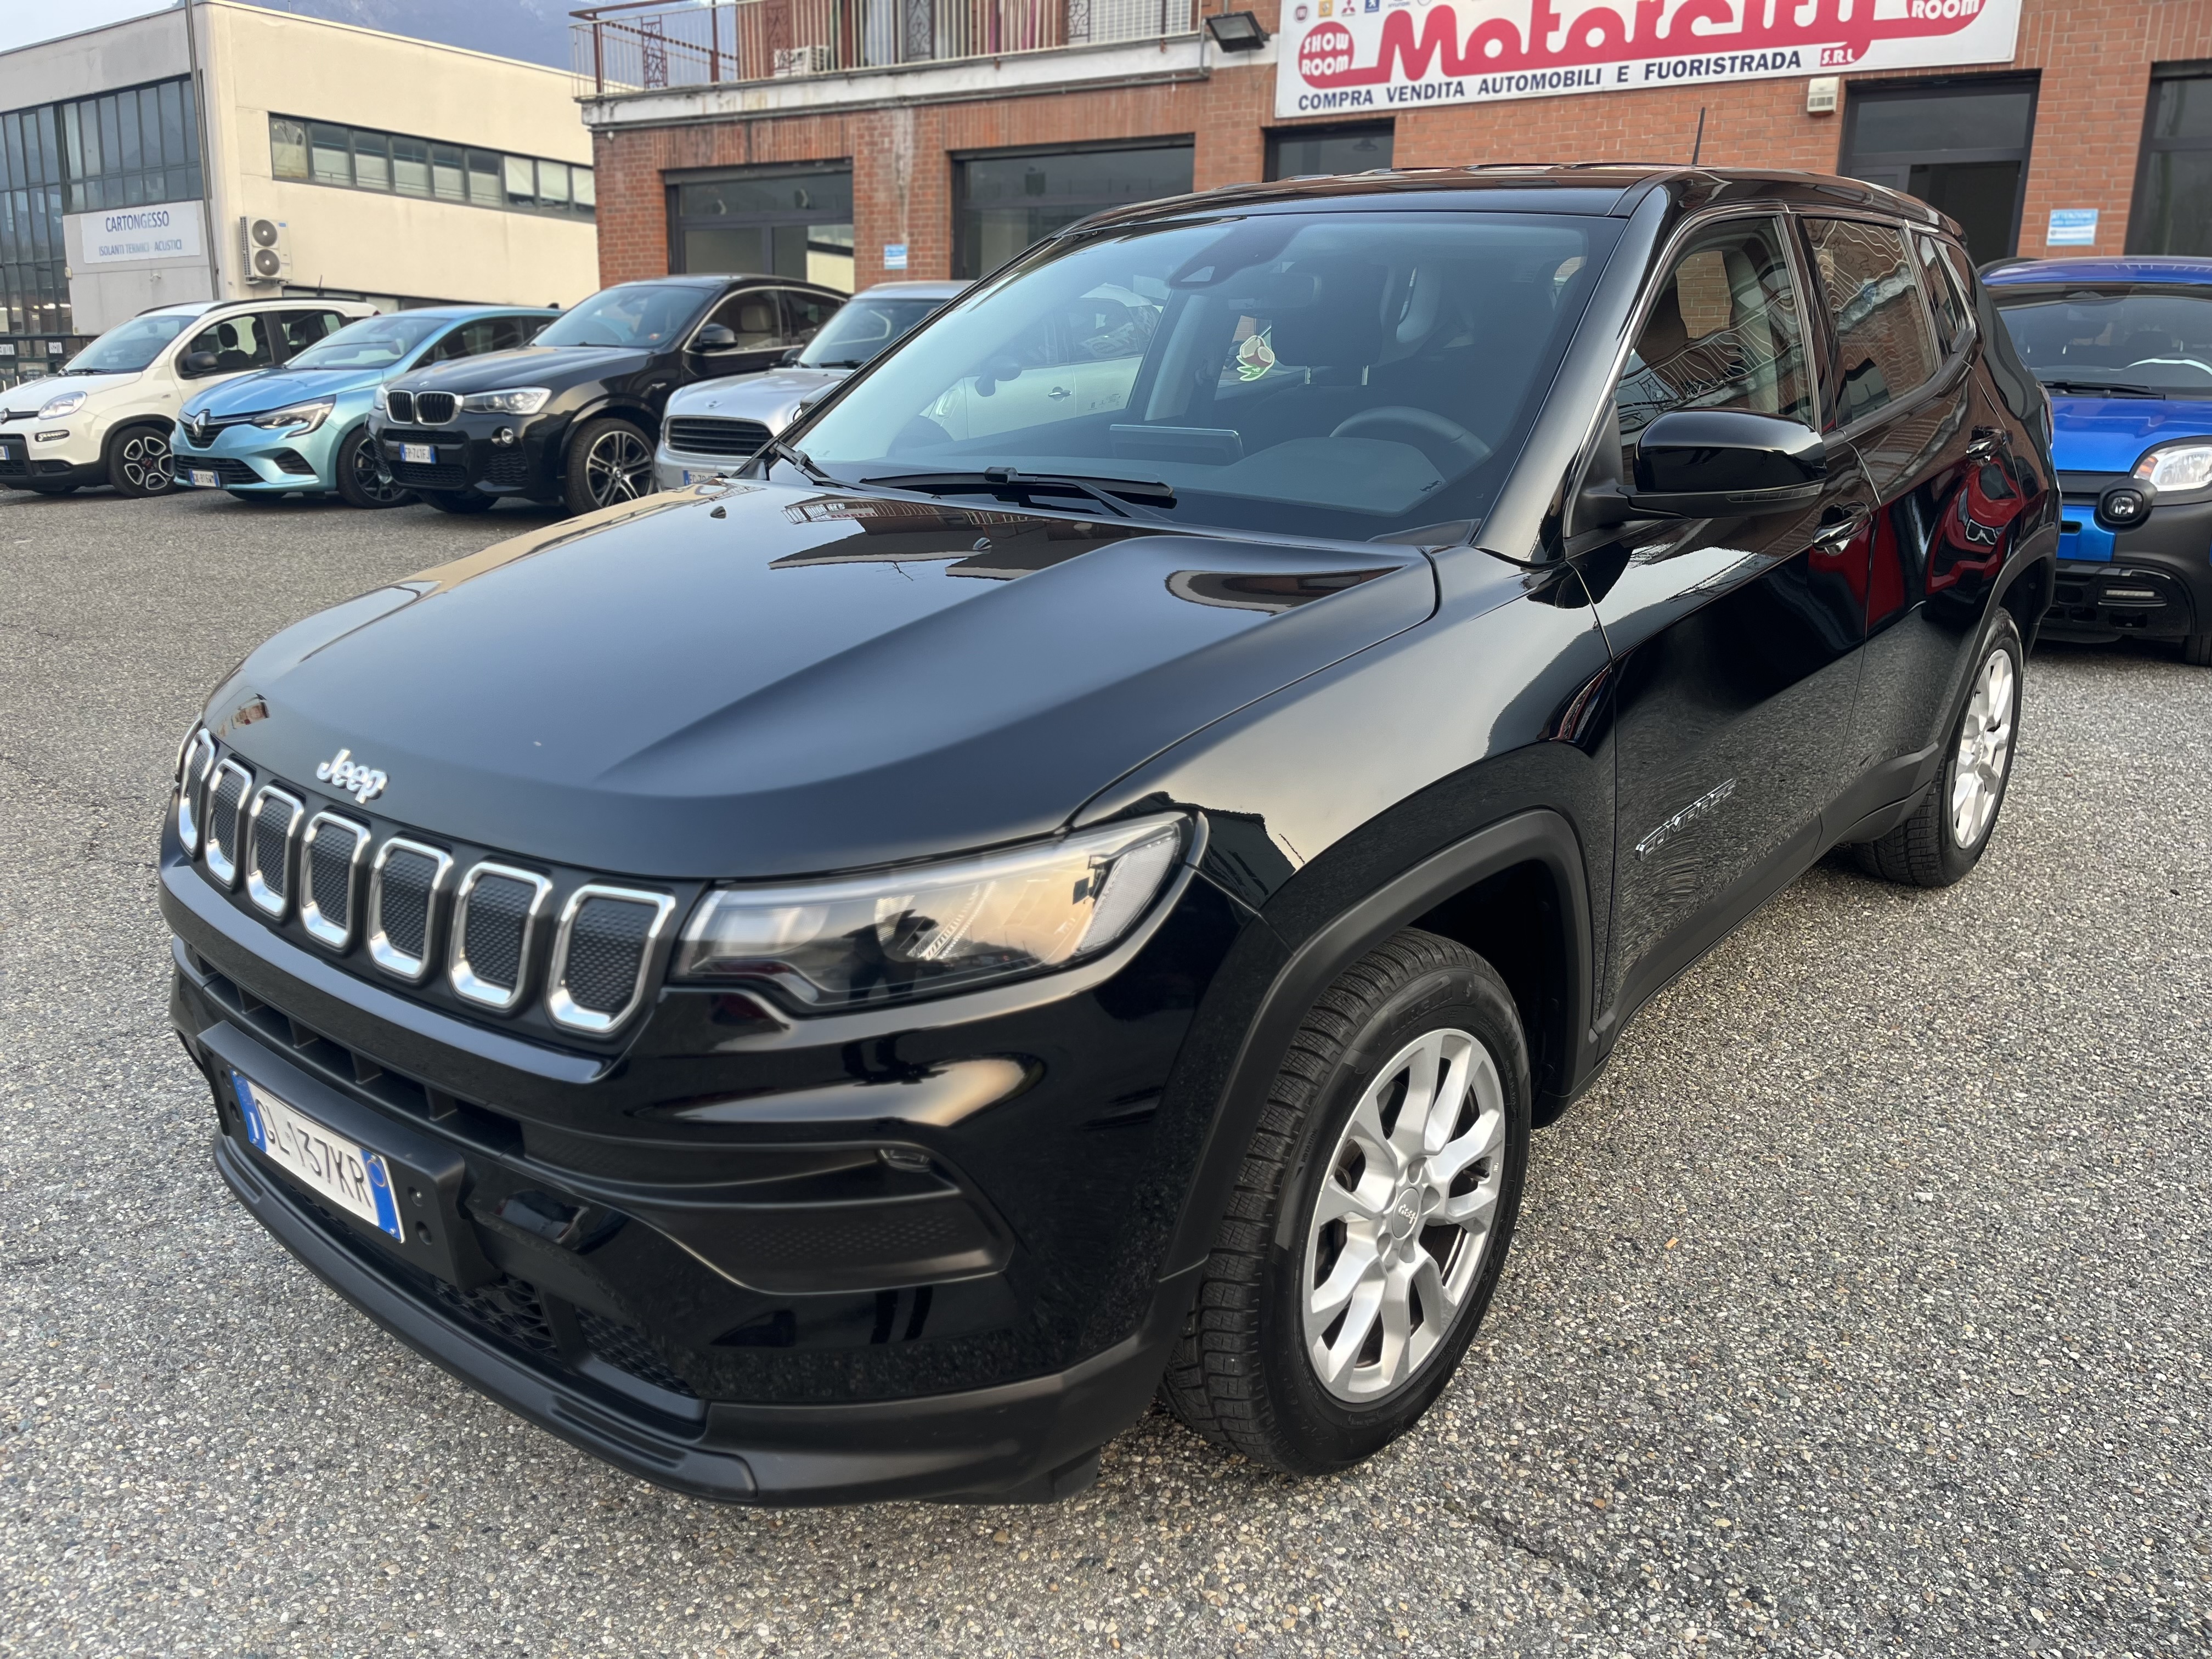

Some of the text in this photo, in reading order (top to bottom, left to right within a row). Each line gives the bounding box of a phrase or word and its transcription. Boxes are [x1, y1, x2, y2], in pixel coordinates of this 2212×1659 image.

[1911, 0, 1979, 19] ROOM
[1303, 32, 1349, 54] SHOW
[1301, 55, 1349, 76] ROOM
[1298, 50, 1802, 111] COMPRA VENDITA AUTOMOBILI E FUORISTRADA
[105, 211, 170, 232] CARTONGESSO
[99, 239, 182, 256] ISOLANTI TERMICI ACUSTICI
[317, 749, 388, 804] Jeep
